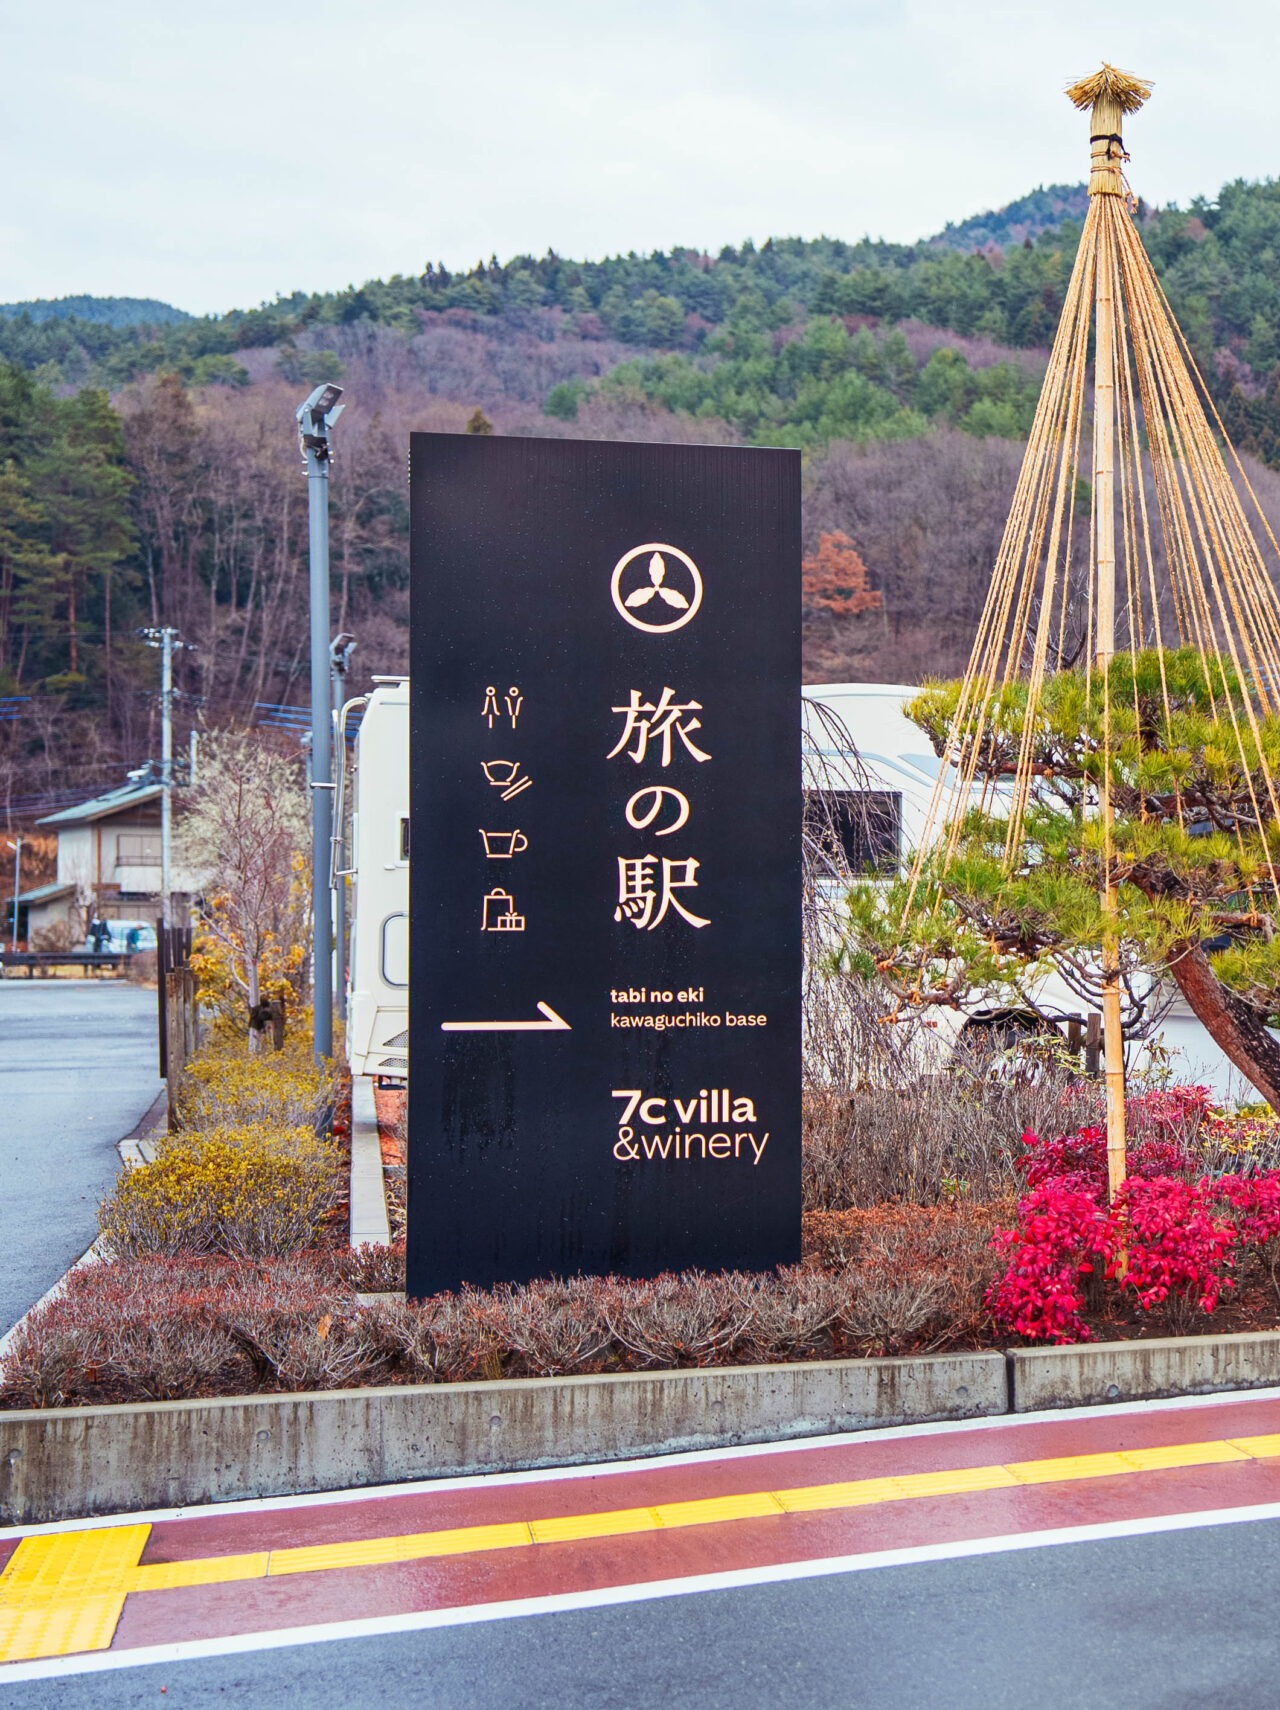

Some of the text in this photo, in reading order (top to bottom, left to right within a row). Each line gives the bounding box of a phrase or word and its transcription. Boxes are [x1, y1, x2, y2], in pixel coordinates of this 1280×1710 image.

[606, 686, 712, 930] 旅の駅
[610, 986, 704, 1003] tabi no eki
[611, 1011, 767, 1031] kawaguchiko base
[611, 1088, 757, 1125] 7c villa
[612, 1126, 770, 1166] &winery
